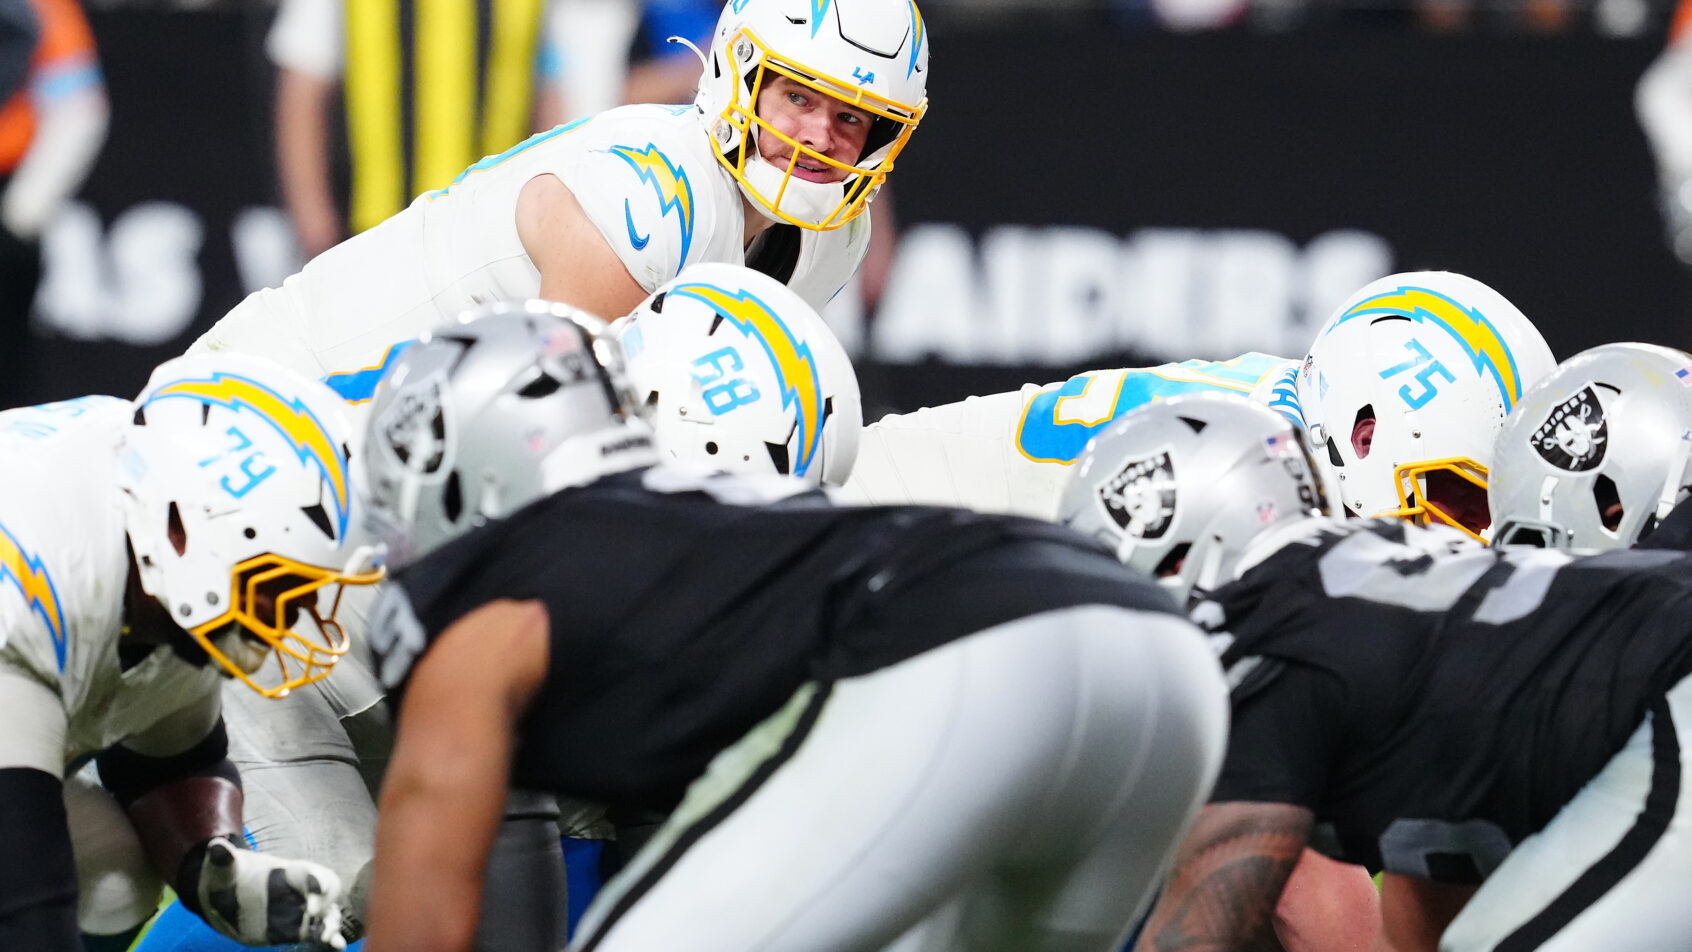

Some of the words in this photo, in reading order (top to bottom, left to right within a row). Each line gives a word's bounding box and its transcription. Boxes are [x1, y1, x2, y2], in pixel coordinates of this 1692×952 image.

[852, 66, 875, 86] LA
[826, 221, 1394, 372] AIDERS
[690, 345, 761, 417] 68
[1378, 337, 1457, 411] 75
[197, 426, 277, 499] 79
